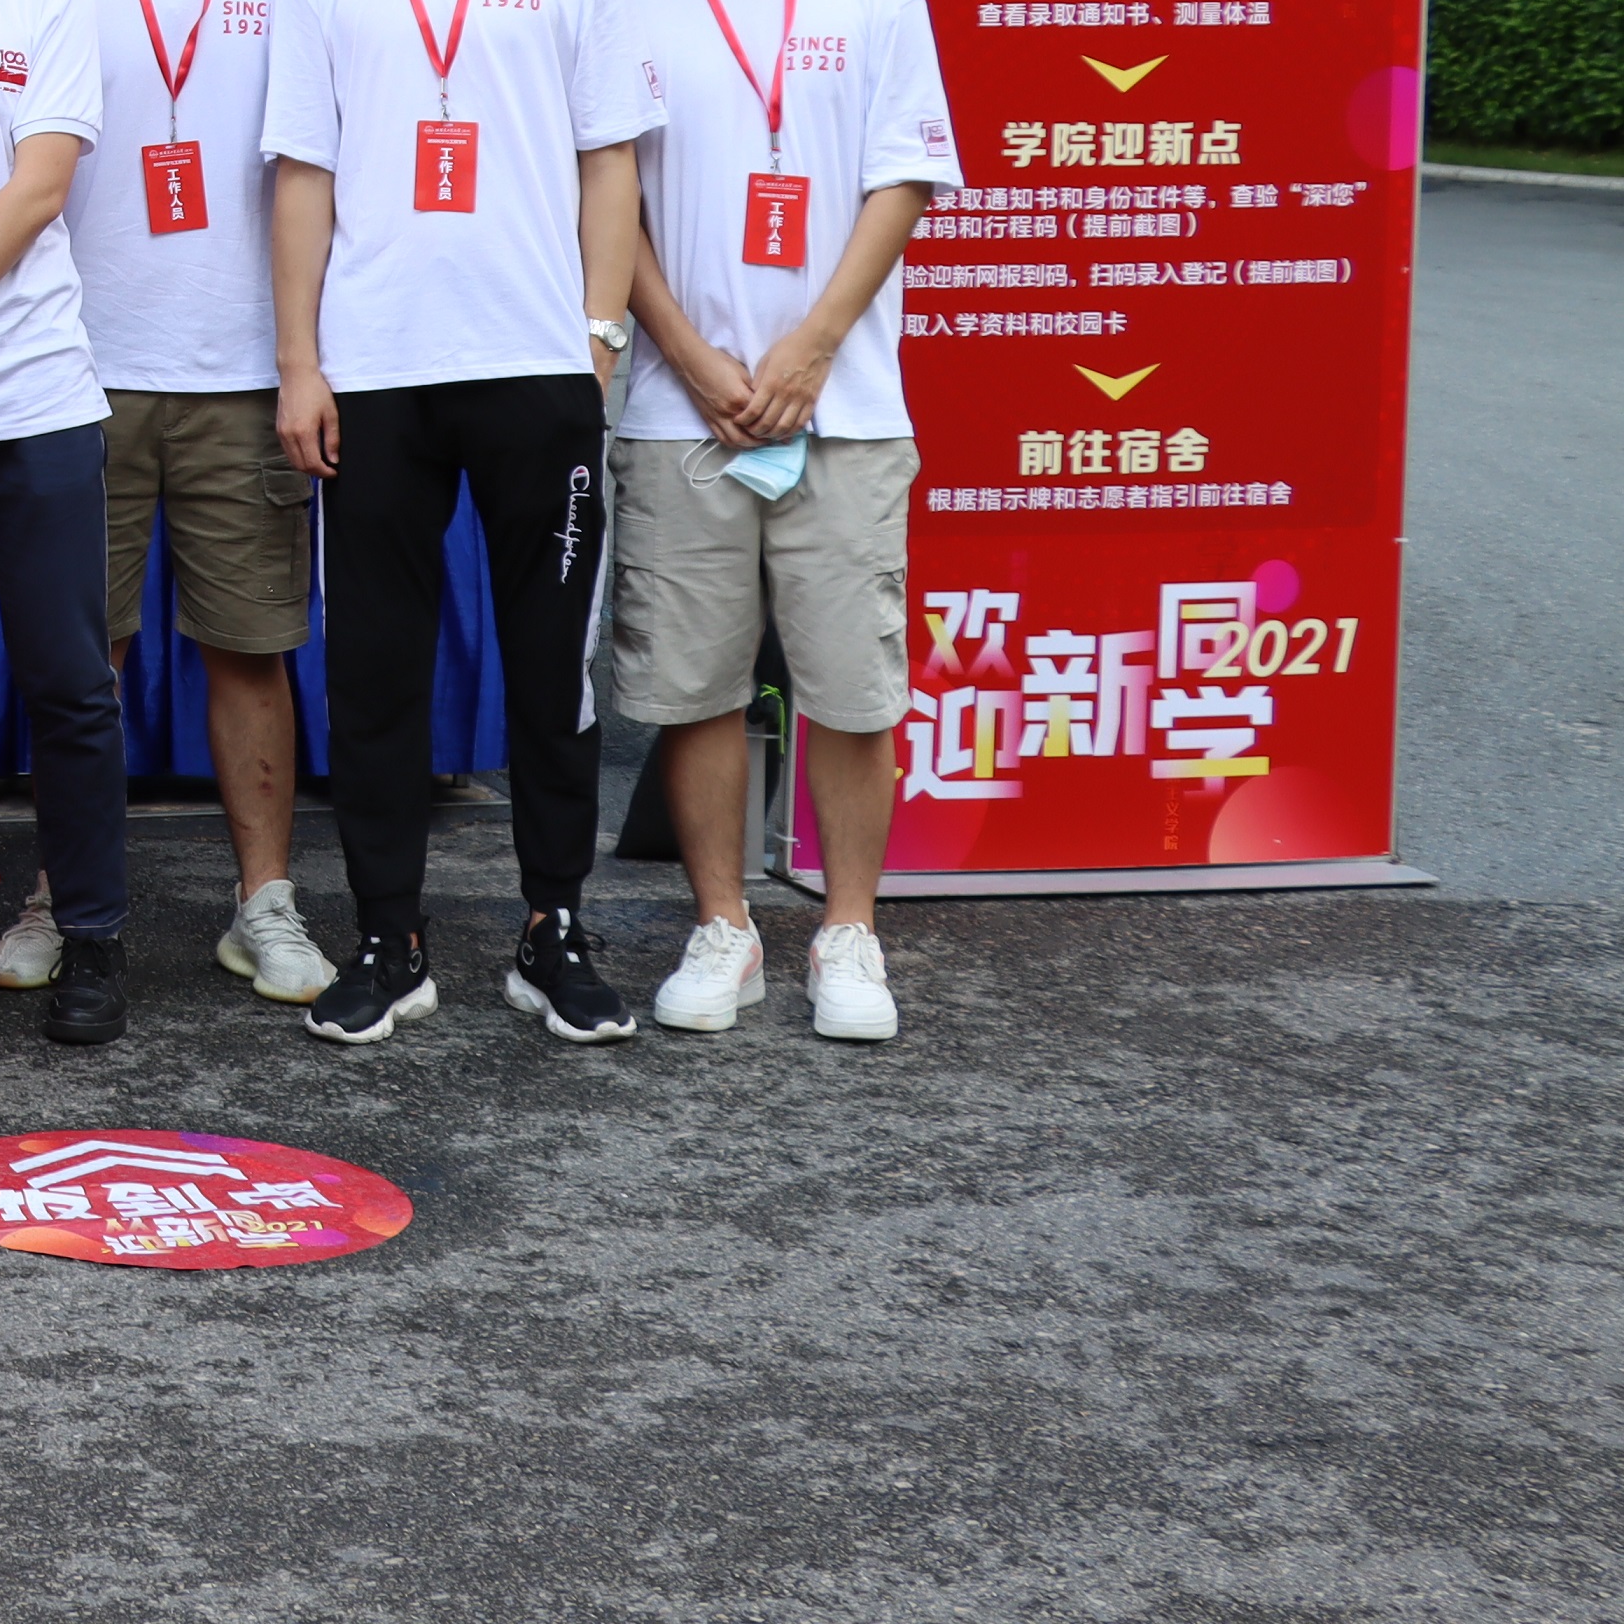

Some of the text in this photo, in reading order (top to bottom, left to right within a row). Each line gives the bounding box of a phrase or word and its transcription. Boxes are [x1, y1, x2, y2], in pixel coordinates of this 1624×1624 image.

[222, 0, 271, 18] SINC
[977, 1, 1271, 29] 查看录取通知书、测量体温
[222, 19, 271, 36] 192
[787, 36, 847, 54] SINCE
[786, 54, 847, 72] 1920
[1000, 120, 1243, 169] 学院迎新点
[438, 147, 454, 201] 工作人员
[166, 168, 185, 220] 工作人员
[766, 202, 784, 255] 工作人员
[902, 257, 1353, 290] 验迎新网报到码，扫码录入登记（提前截图）
[902, 311, 1128, 338] 取入学资料和校园卡
[1018, 428, 1211, 476] 前往宿舍
[927, 481, 1294, 513] 根据指示牌和志愿者指引前往宿舍
[1201, 616, 1360, 679] 2021
